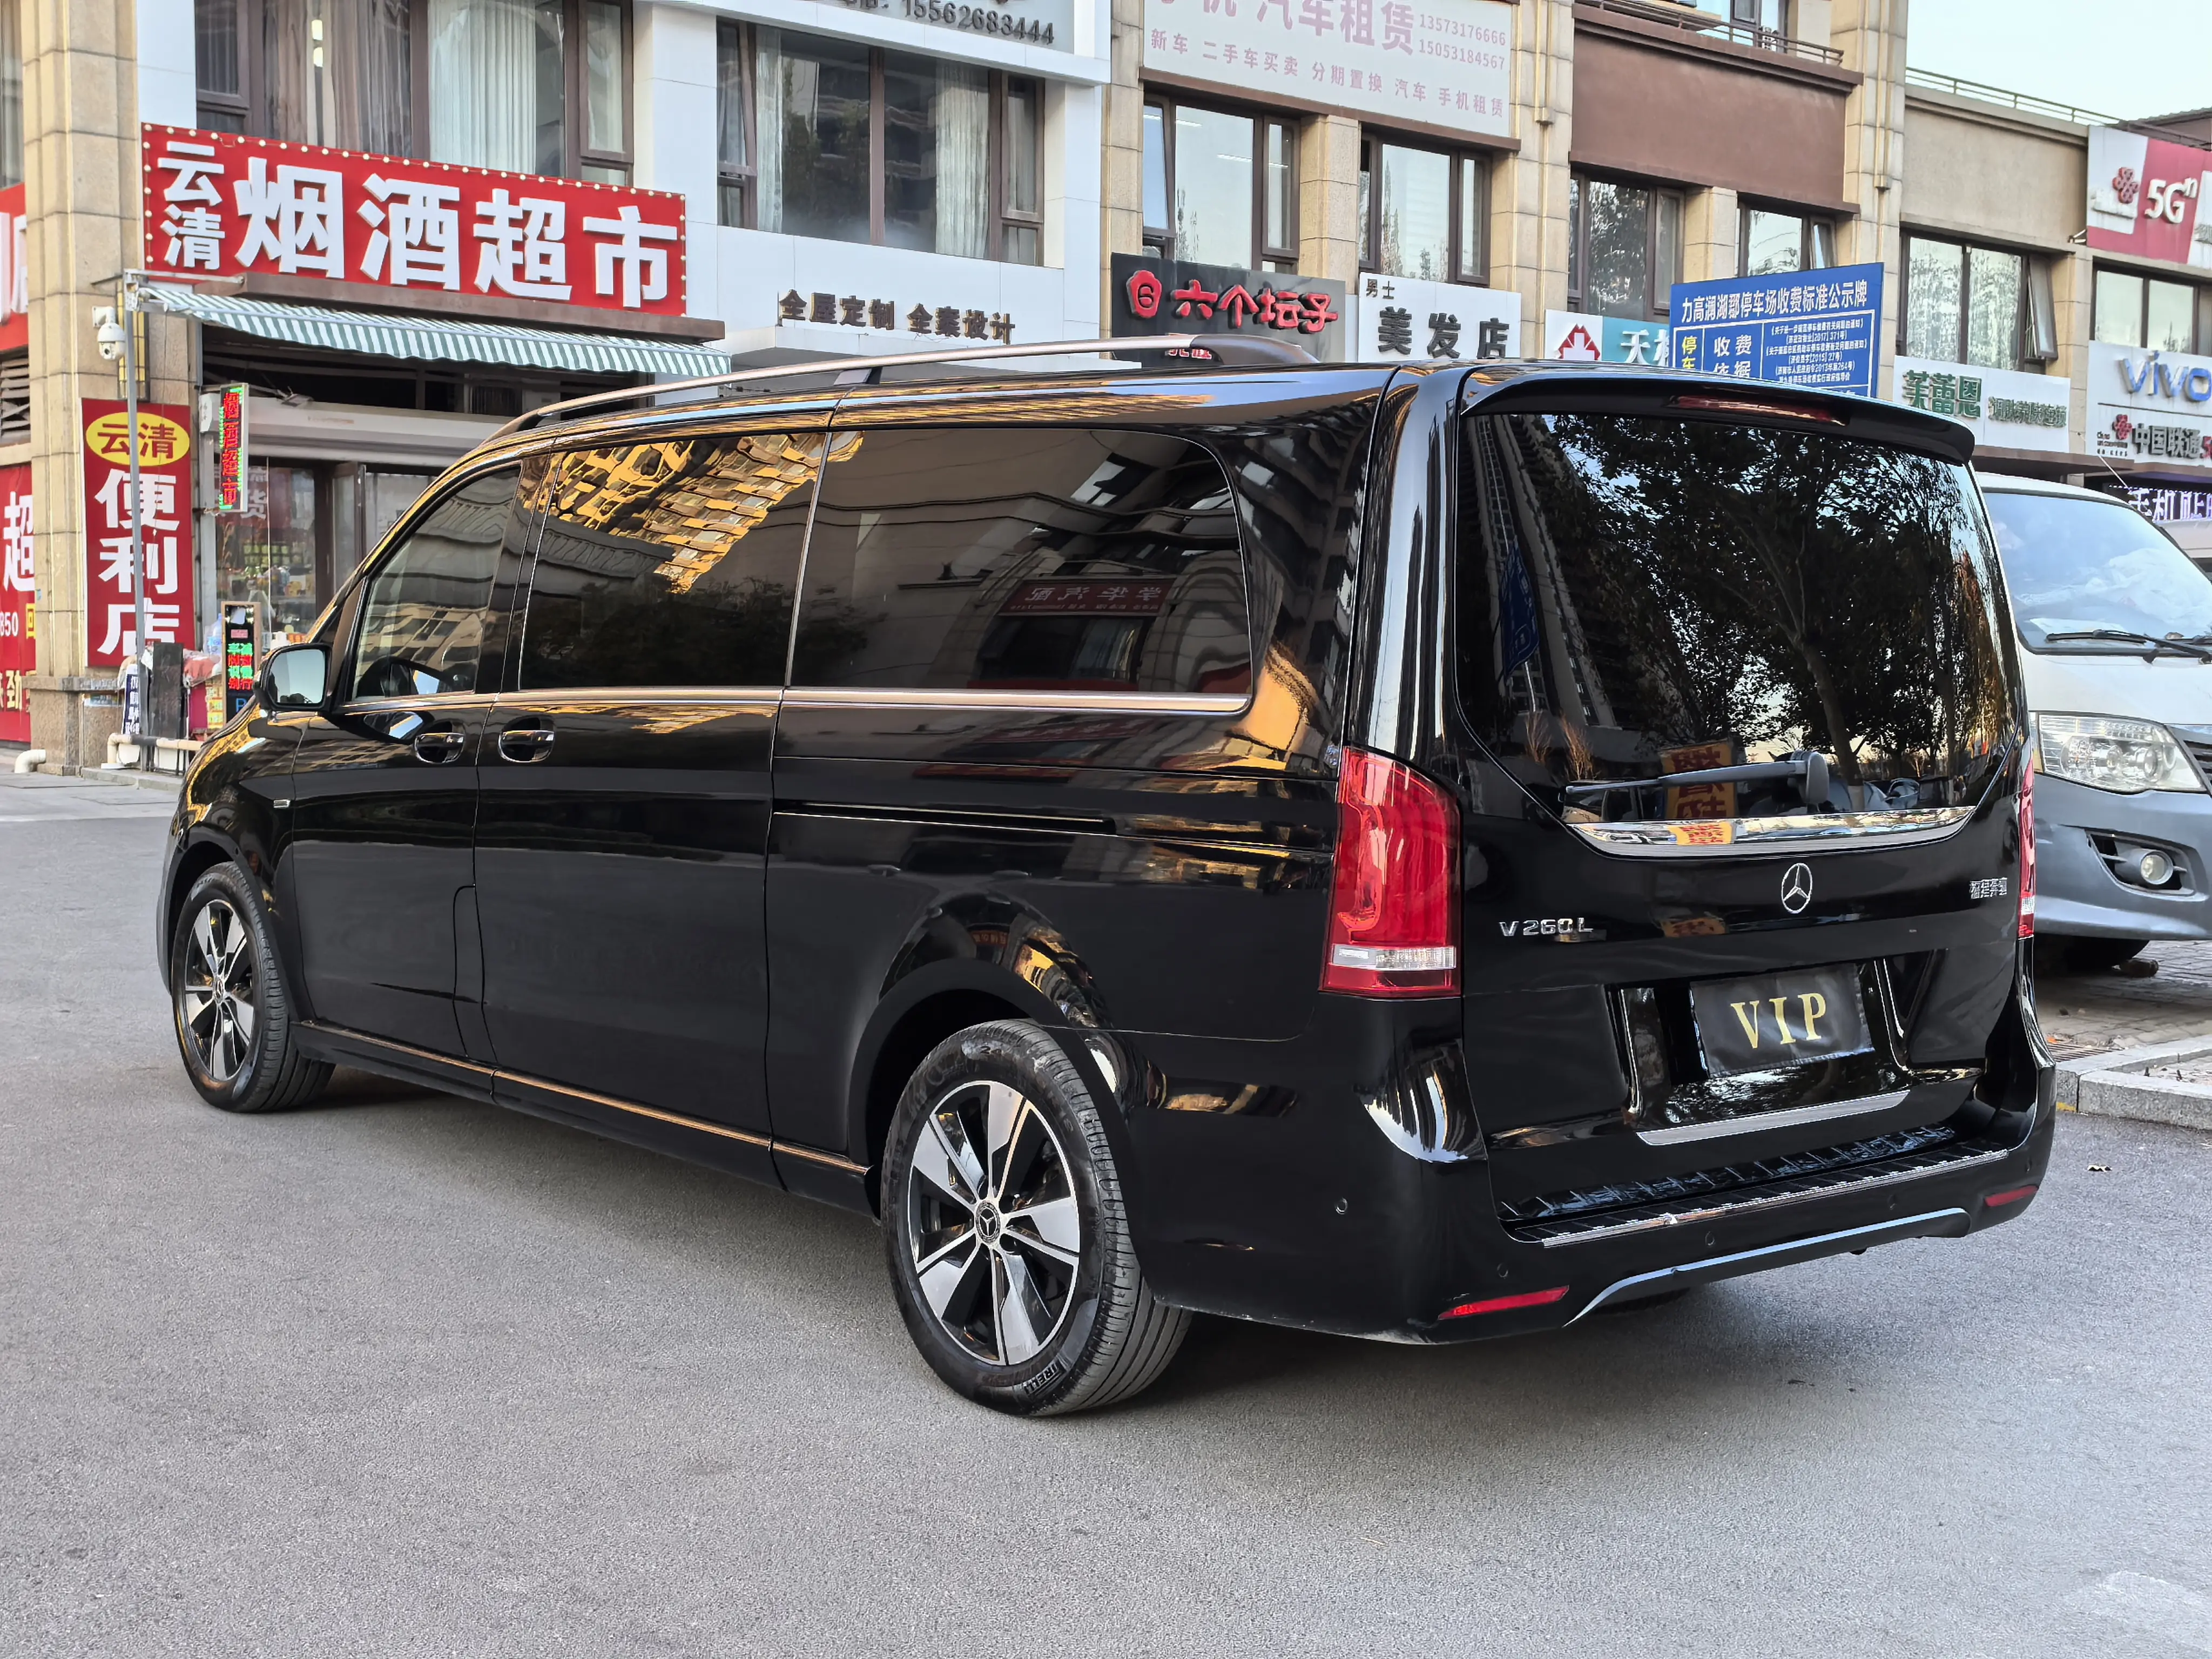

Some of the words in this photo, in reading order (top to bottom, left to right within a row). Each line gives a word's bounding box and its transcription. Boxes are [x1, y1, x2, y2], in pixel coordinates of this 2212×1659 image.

[905, 0, 1054, 45] 15562683444
[1419, 14, 1507, 46] 13573176666
[1151, 29, 1189, 53] 新车
[1202, 42, 1299, 77] 二手车买卖
[1312, 62, 1384, 95] 分期置换
[1394, 78, 1427, 102] 汽车
[1439, 88, 1504, 118] 手机租赁
[1418, 41, 1505, 70] 15053184567
[157, 141, 225, 270] 云清
[233, 156, 678, 308] 烟酒超市
[779, 288, 896, 331] 全屋定制
[907, 303, 1016, 345] 全案设计
[1170, 279, 1339, 335] 六个坛子
[1365, 279, 1396, 301] 男士
[1377, 306, 1511, 360] 美发店
[1714, 335, 1752, 358] 收费
[2117, 350, 2211, 402] vivo
[97, 422, 177, 459] 云清
[2132, 423, 2201, 459] 中国联通
[95, 468, 180, 657] 便利店
[1730, 992, 1826, 1049] VIP
